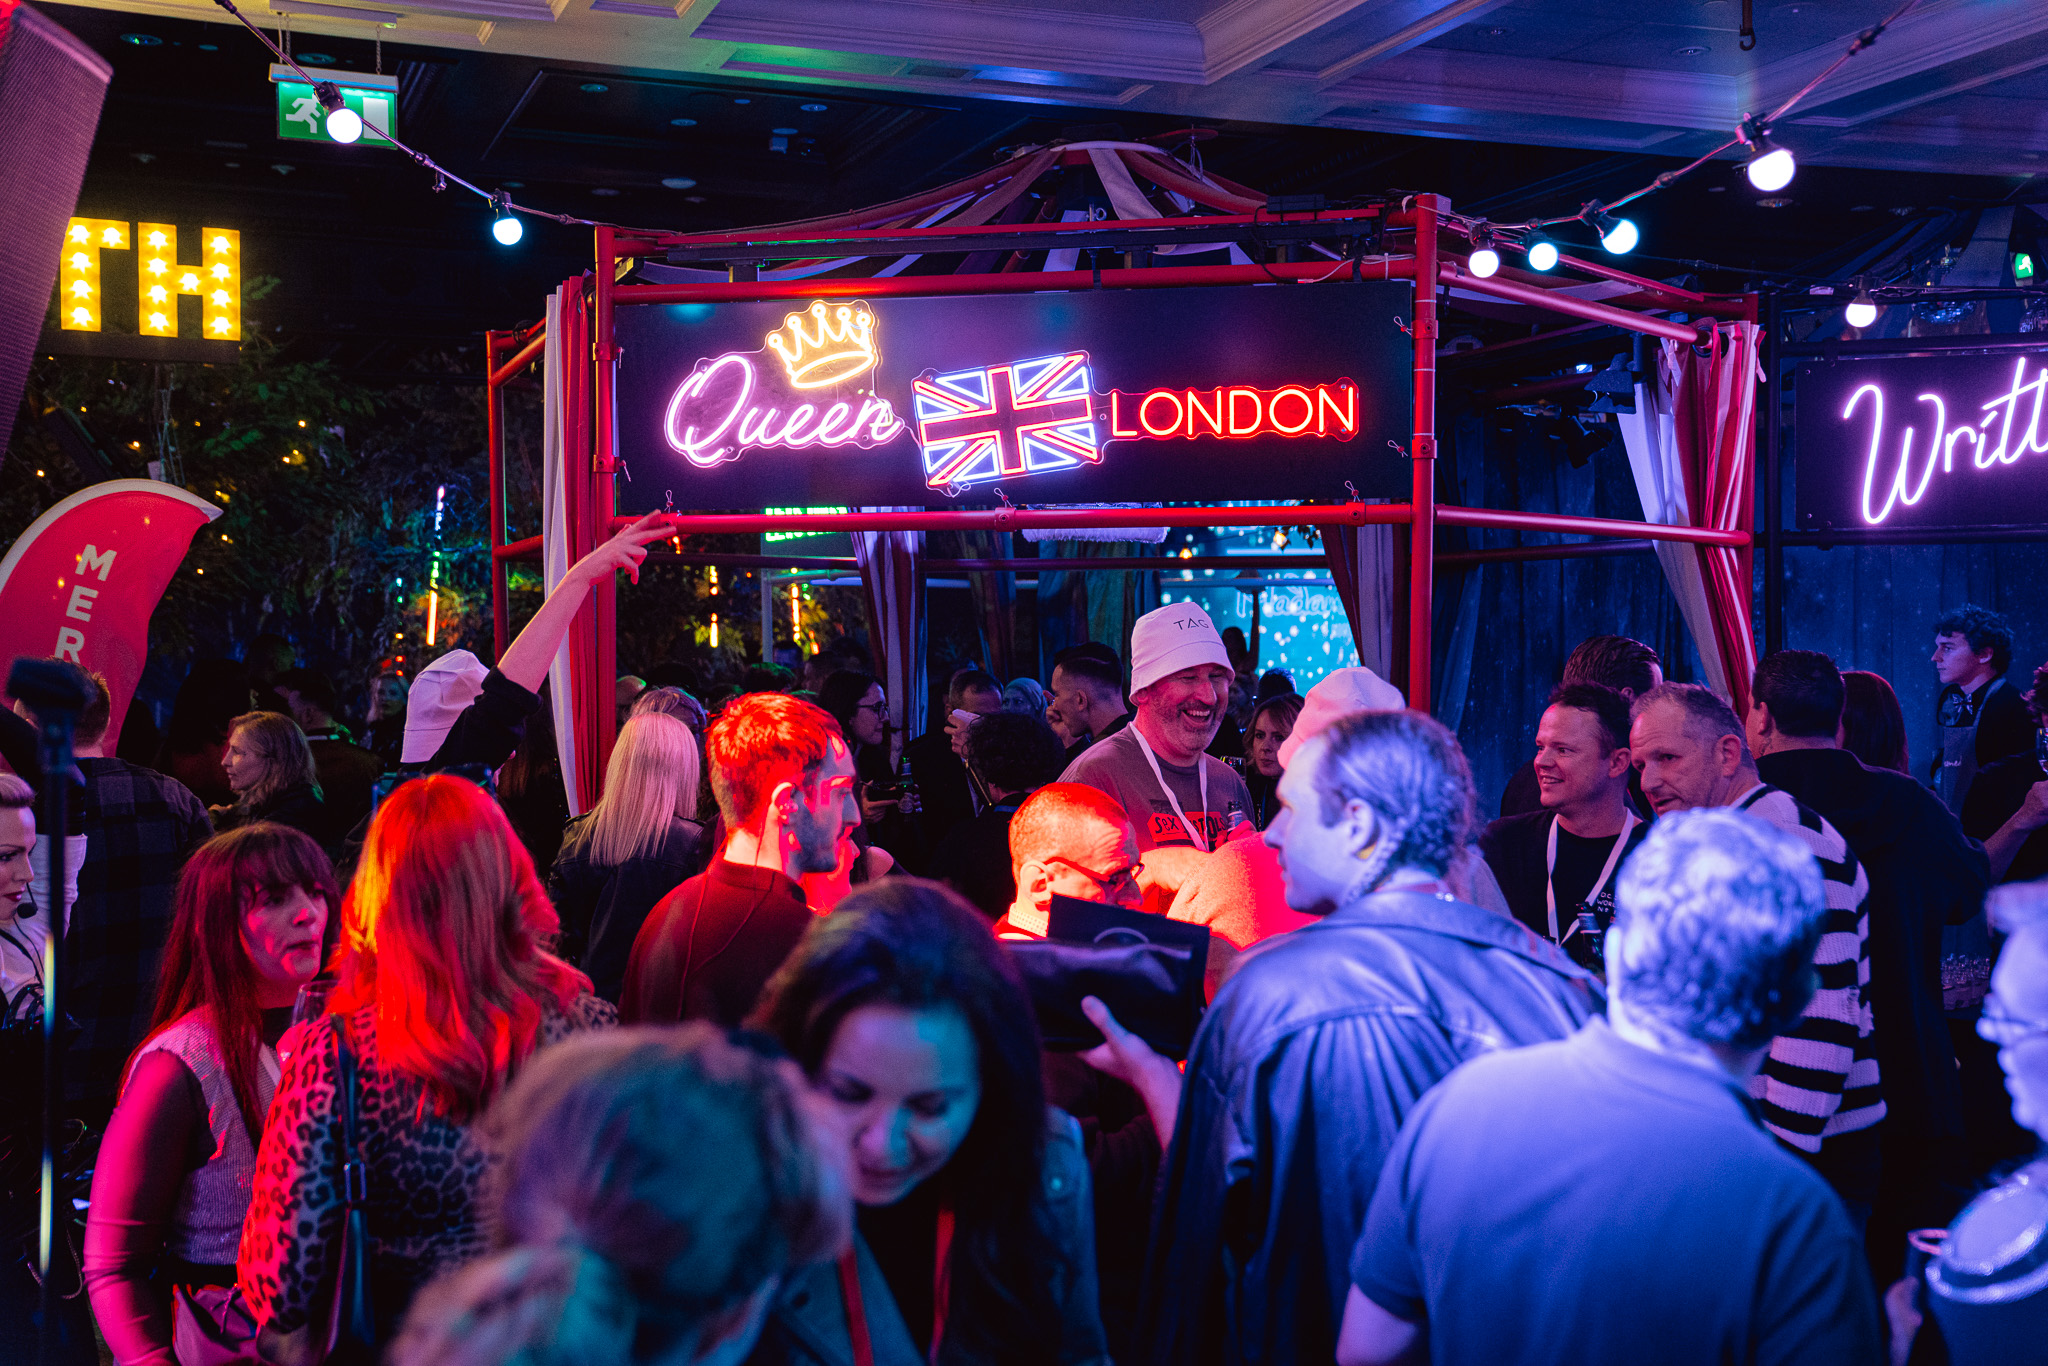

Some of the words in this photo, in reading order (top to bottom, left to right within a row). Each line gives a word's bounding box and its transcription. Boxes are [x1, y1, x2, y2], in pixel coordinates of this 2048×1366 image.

[665, 354, 901, 464] Queen
[1110, 387, 1355, 437] LONDON
[54, 543, 118, 664] MER
[1172, 617, 1210, 631] TAG
